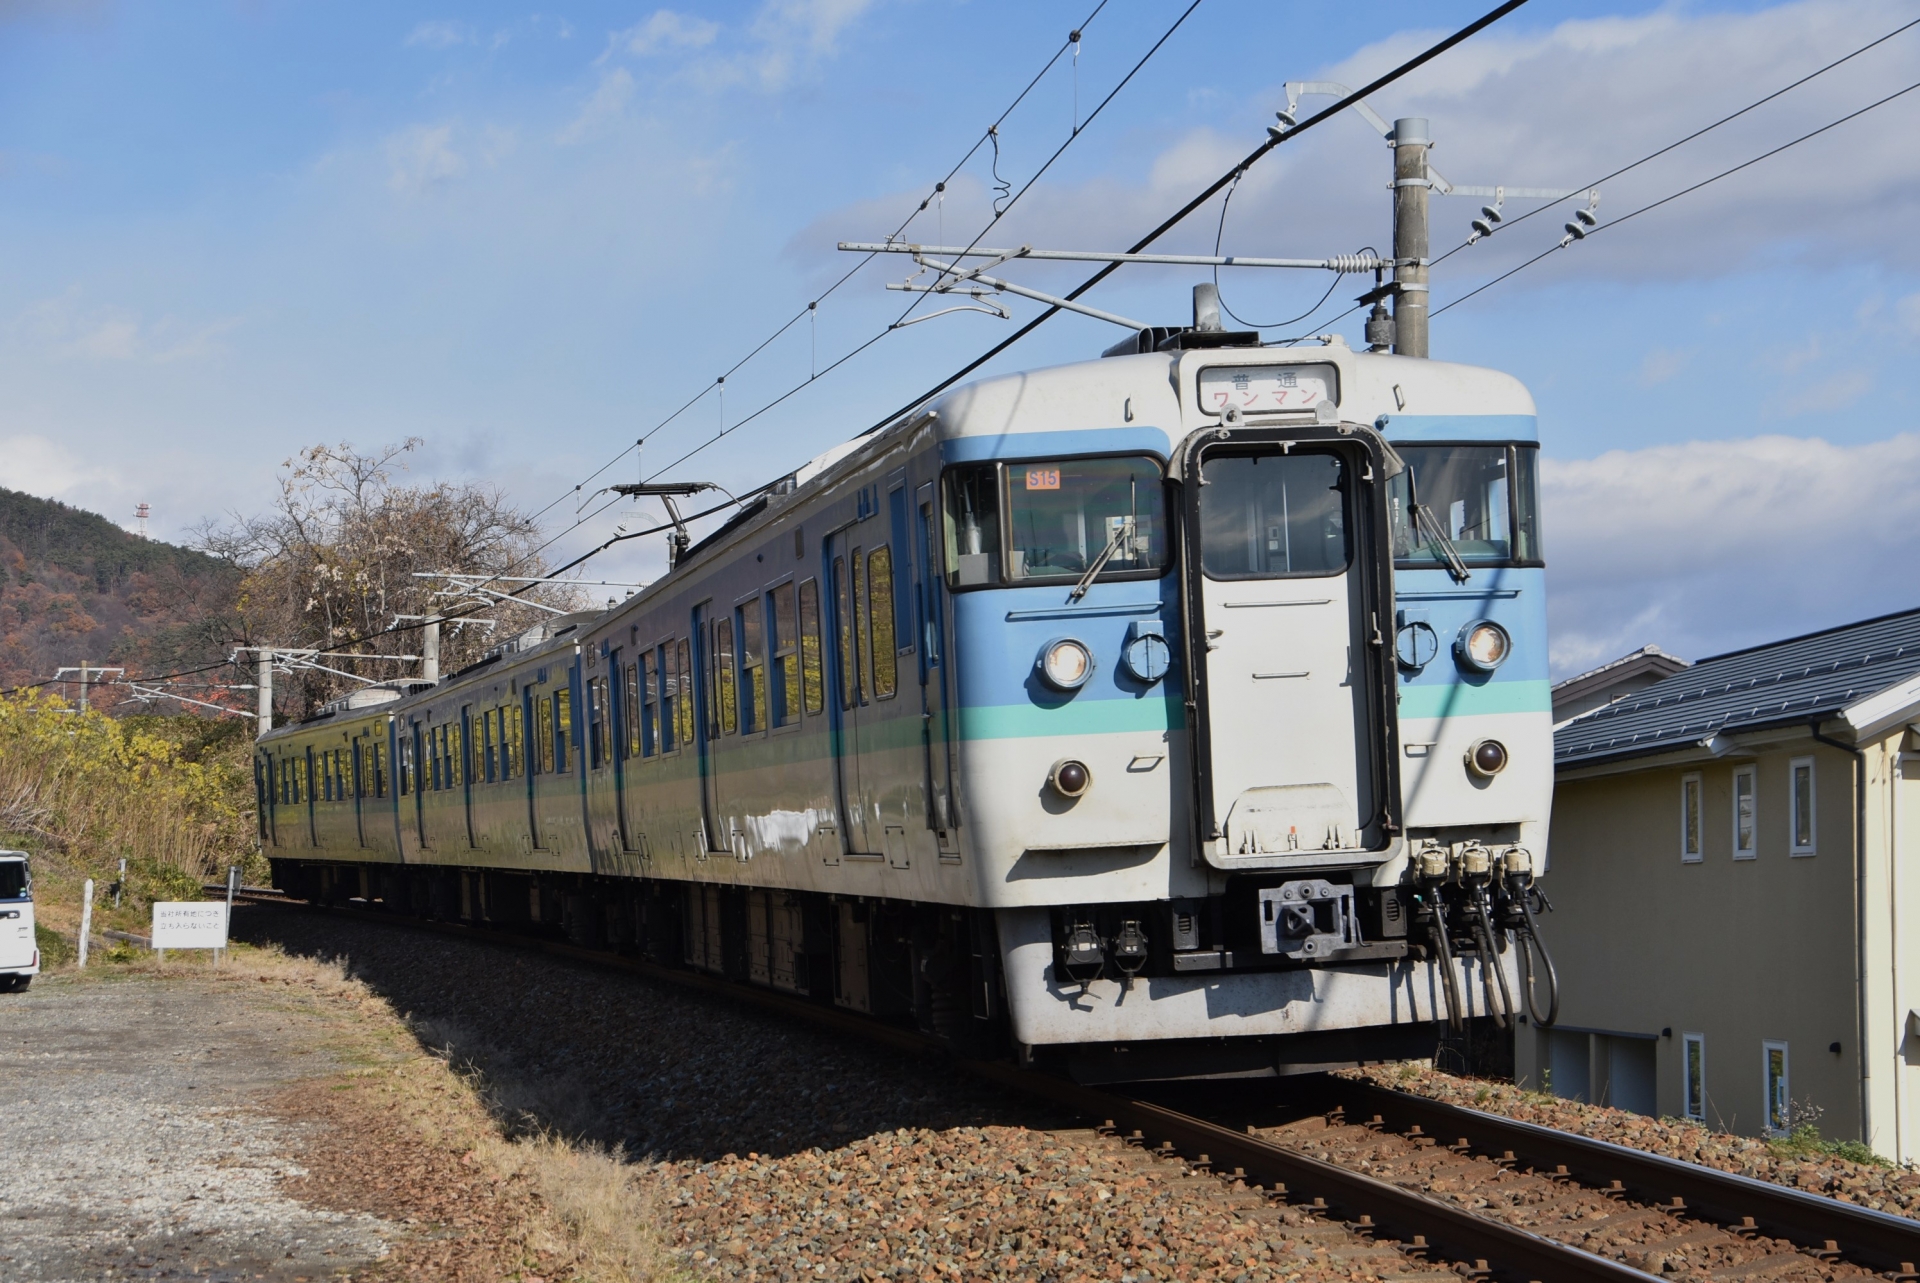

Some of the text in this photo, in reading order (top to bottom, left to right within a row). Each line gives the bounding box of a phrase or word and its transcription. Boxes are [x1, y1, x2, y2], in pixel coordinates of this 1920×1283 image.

[1231, 372, 1298, 390] 普通
[1214, 389, 1317, 407] ワンマン
[1029, 469, 1057, 487] S15
[160, 910, 219, 918] 当社所有地につき
[160, 922, 220, 930] 立ち入らないこと
